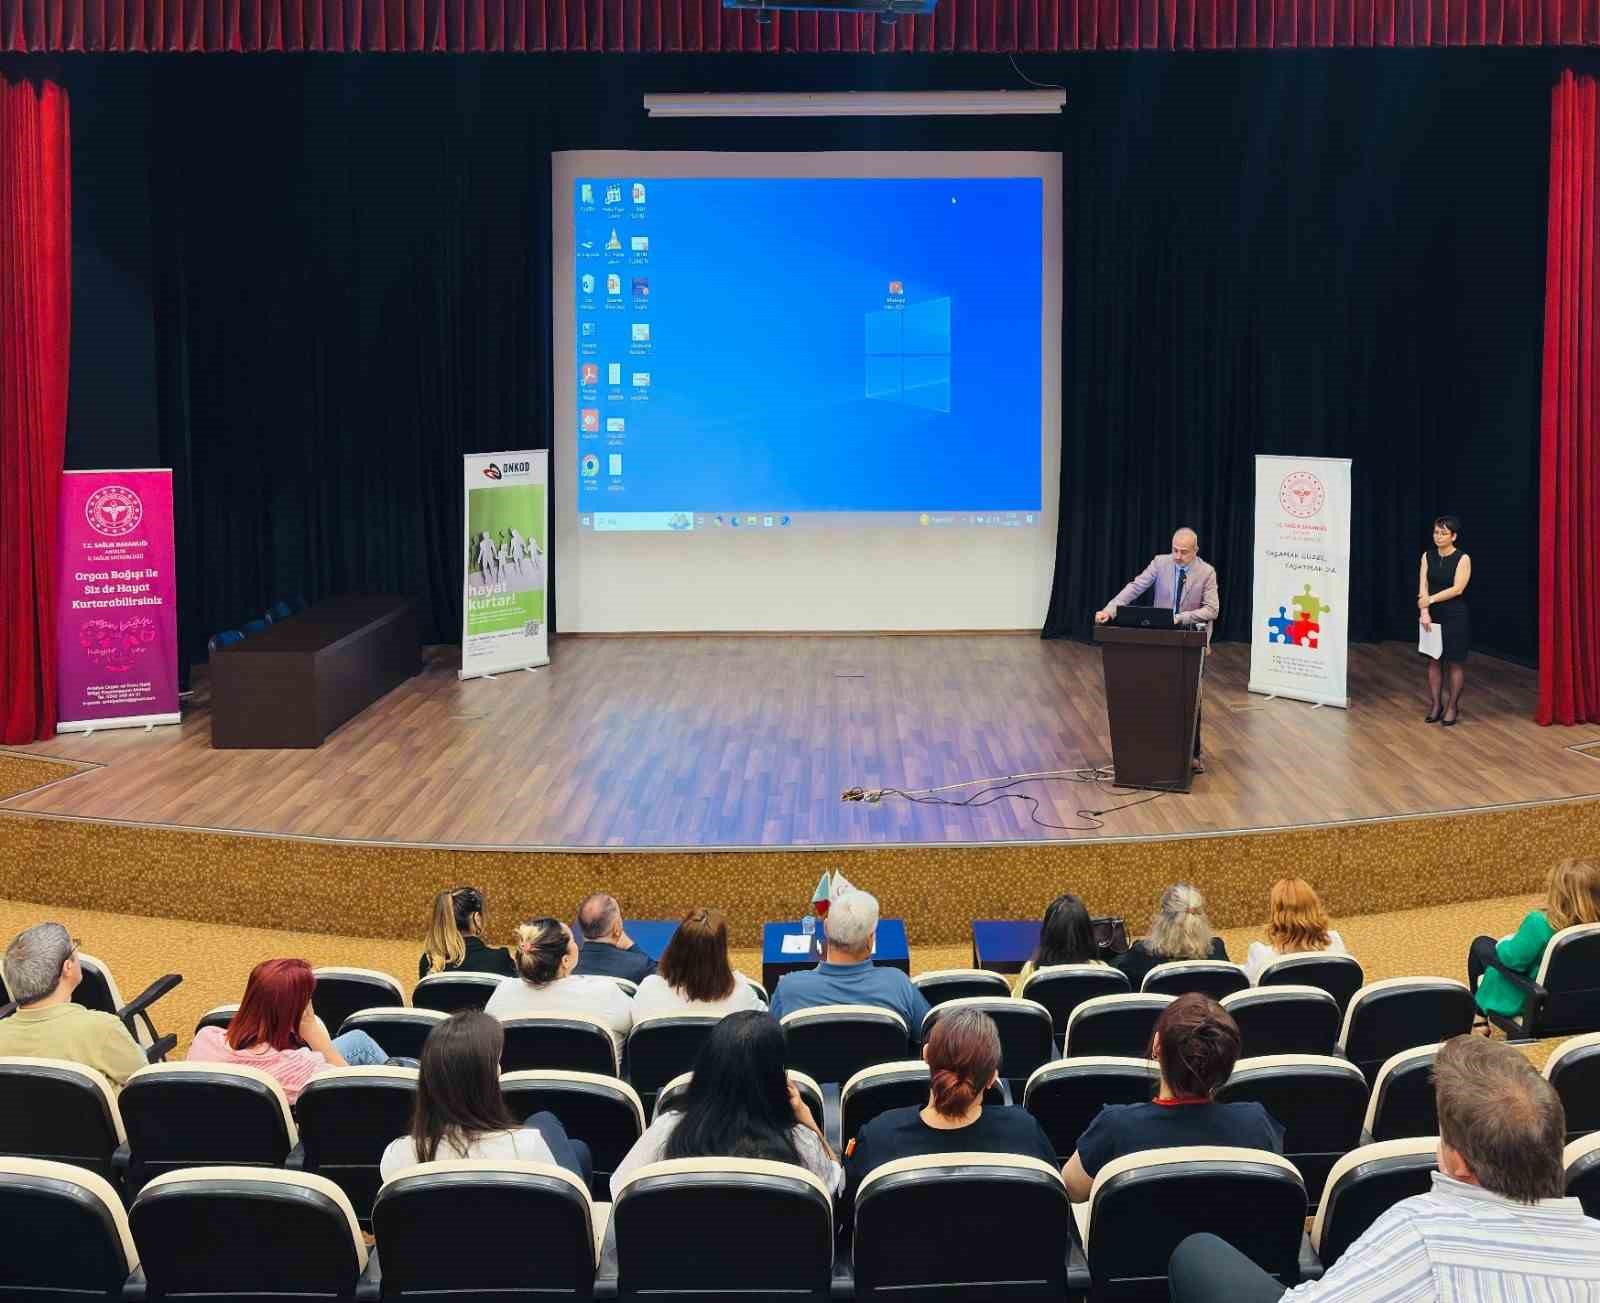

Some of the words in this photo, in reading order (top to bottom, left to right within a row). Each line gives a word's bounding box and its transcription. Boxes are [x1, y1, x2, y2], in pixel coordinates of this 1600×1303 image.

[75, 571, 109, 582] Organ
[111, 569, 144, 581] Bağışı
[145, 568, 159, 578] ile
[84, 585, 100, 594] Siz
[102, 584, 115, 594] de
[117, 583, 150, 594] Hayat
[468, 581, 507, 598] hayat
[72, 595, 163, 609] Kurtarabilirsiniz
[469, 592, 516, 609] kurtar!
